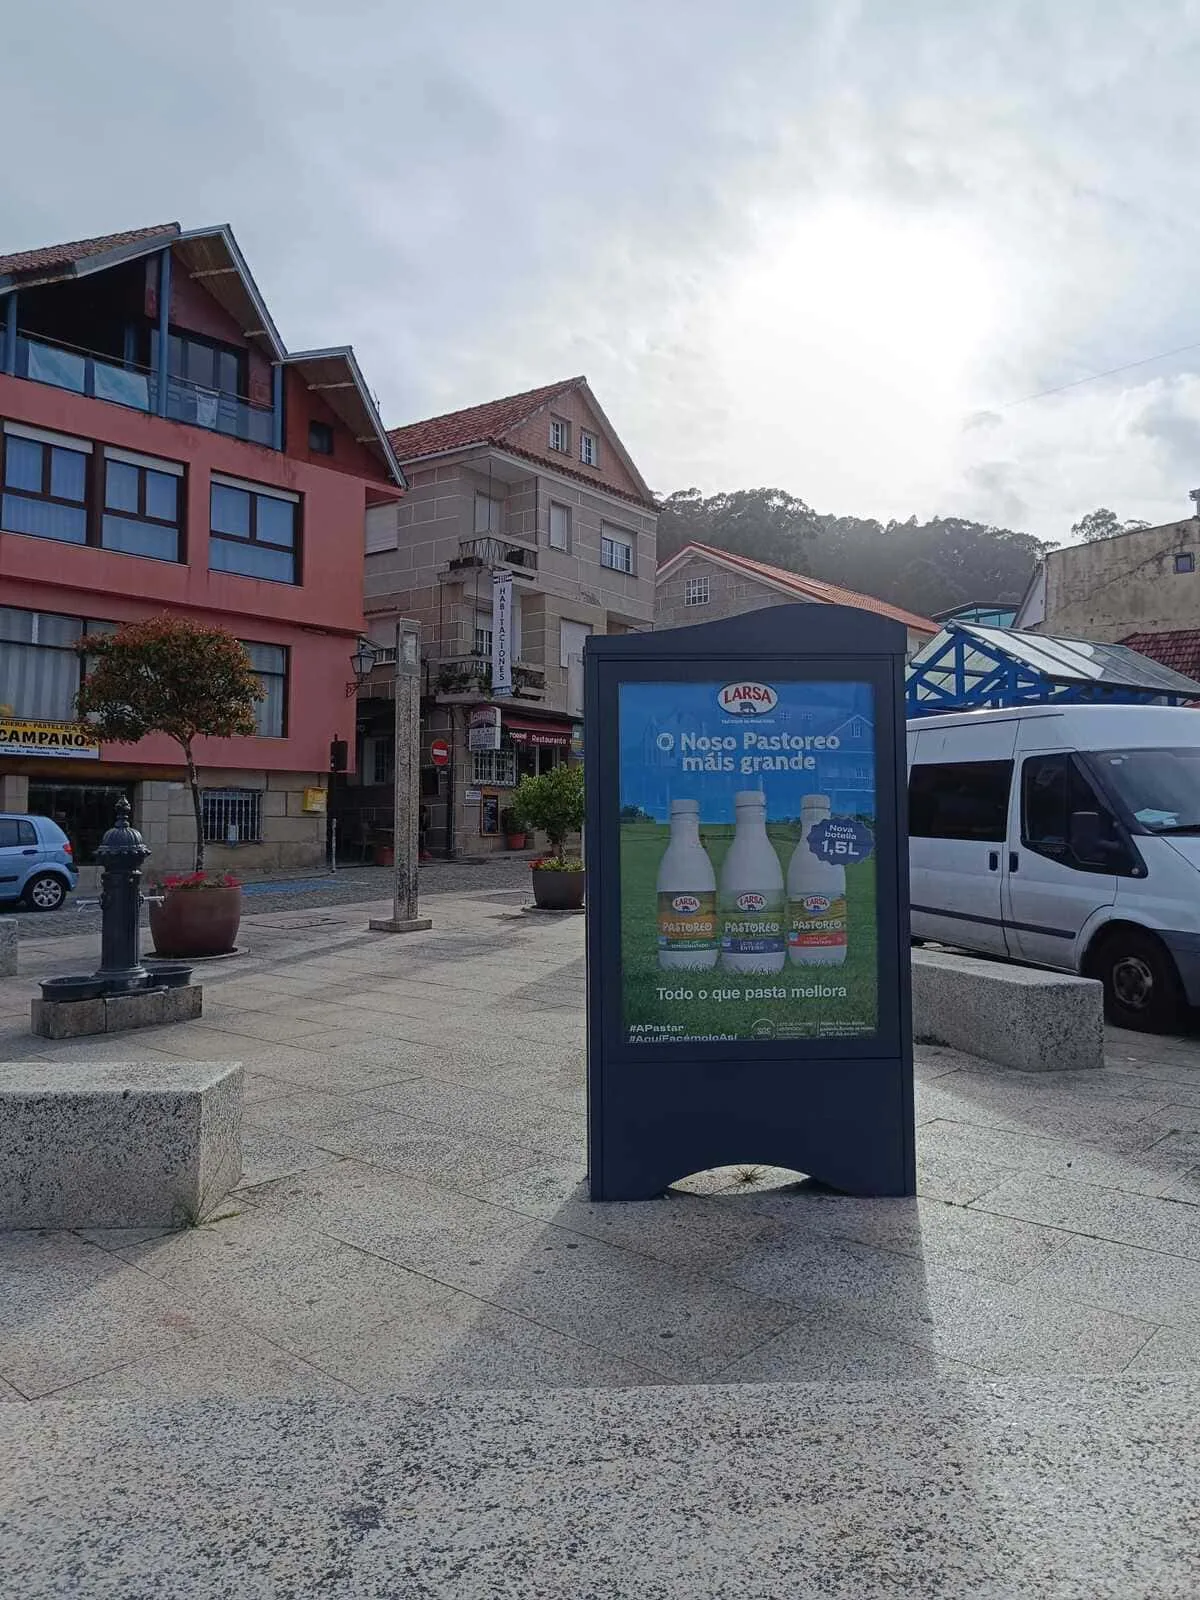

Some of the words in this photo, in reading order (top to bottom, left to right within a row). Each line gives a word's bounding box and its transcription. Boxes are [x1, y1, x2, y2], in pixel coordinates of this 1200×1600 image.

[498, 587, 507, 681] HABITACIONES
[723, 686, 772, 704] LARSA
[0, 729, 86, 746] CAMPANO
[531, 734, 567, 745] Restaurante
[656, 733, 675, 751] O
[680, 732, 737, 751] Noso
[743, 732, 841, 751] Pastoreo
[682, 752, 735, 772] máis
[739, 752, 817, 775] grande
[829, 824, 854, 833] Nova
[824, 830, 857, 841] botella
[821, 839, 860, 856] 1,5L
[675, 895, 698, 907] LARSA
[740, 893, 764, 905] LARSA
[806, 896, 828, 907] LARSA
[724, 921, 780, 933] PASTOREO
[792, 920, 842, 930] PASTOREO
[656, 987, 694, 1001] Todo
[698, 990, 708, 1000] o
[712, 988, 741, 1002] que
[745, 986, 787, 1002] pasta
[791, 985, 847, 999] mellora
[629, 1024, 685, 1033] #APastar
